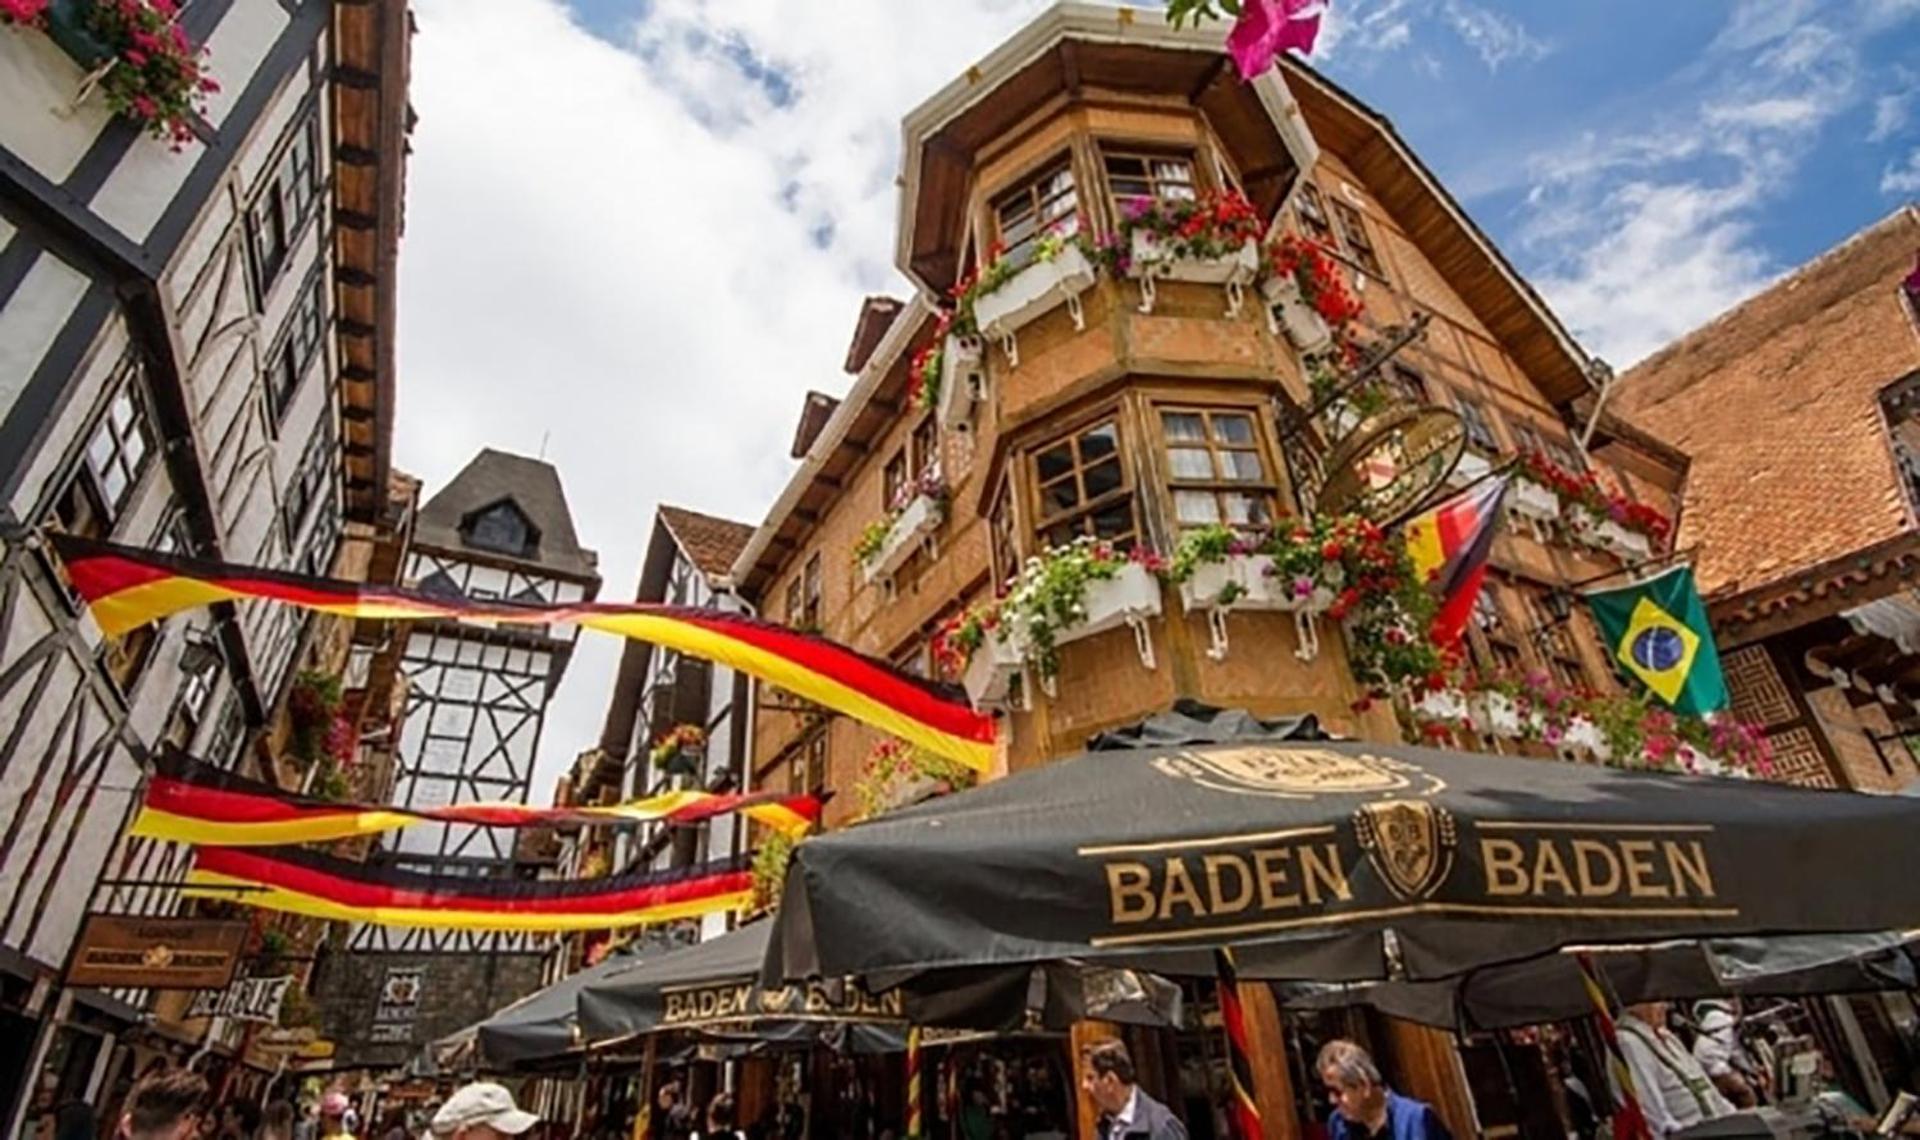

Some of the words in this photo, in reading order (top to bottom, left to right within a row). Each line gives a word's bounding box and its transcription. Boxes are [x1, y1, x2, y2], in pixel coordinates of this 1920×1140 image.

[1105, 844, 1352, 923] BADEN
[1480, 839, 1715, 896] BADEN
[666, 984, 751, 1021] BADEN
[805, 981, 901, 1014] BDEN
